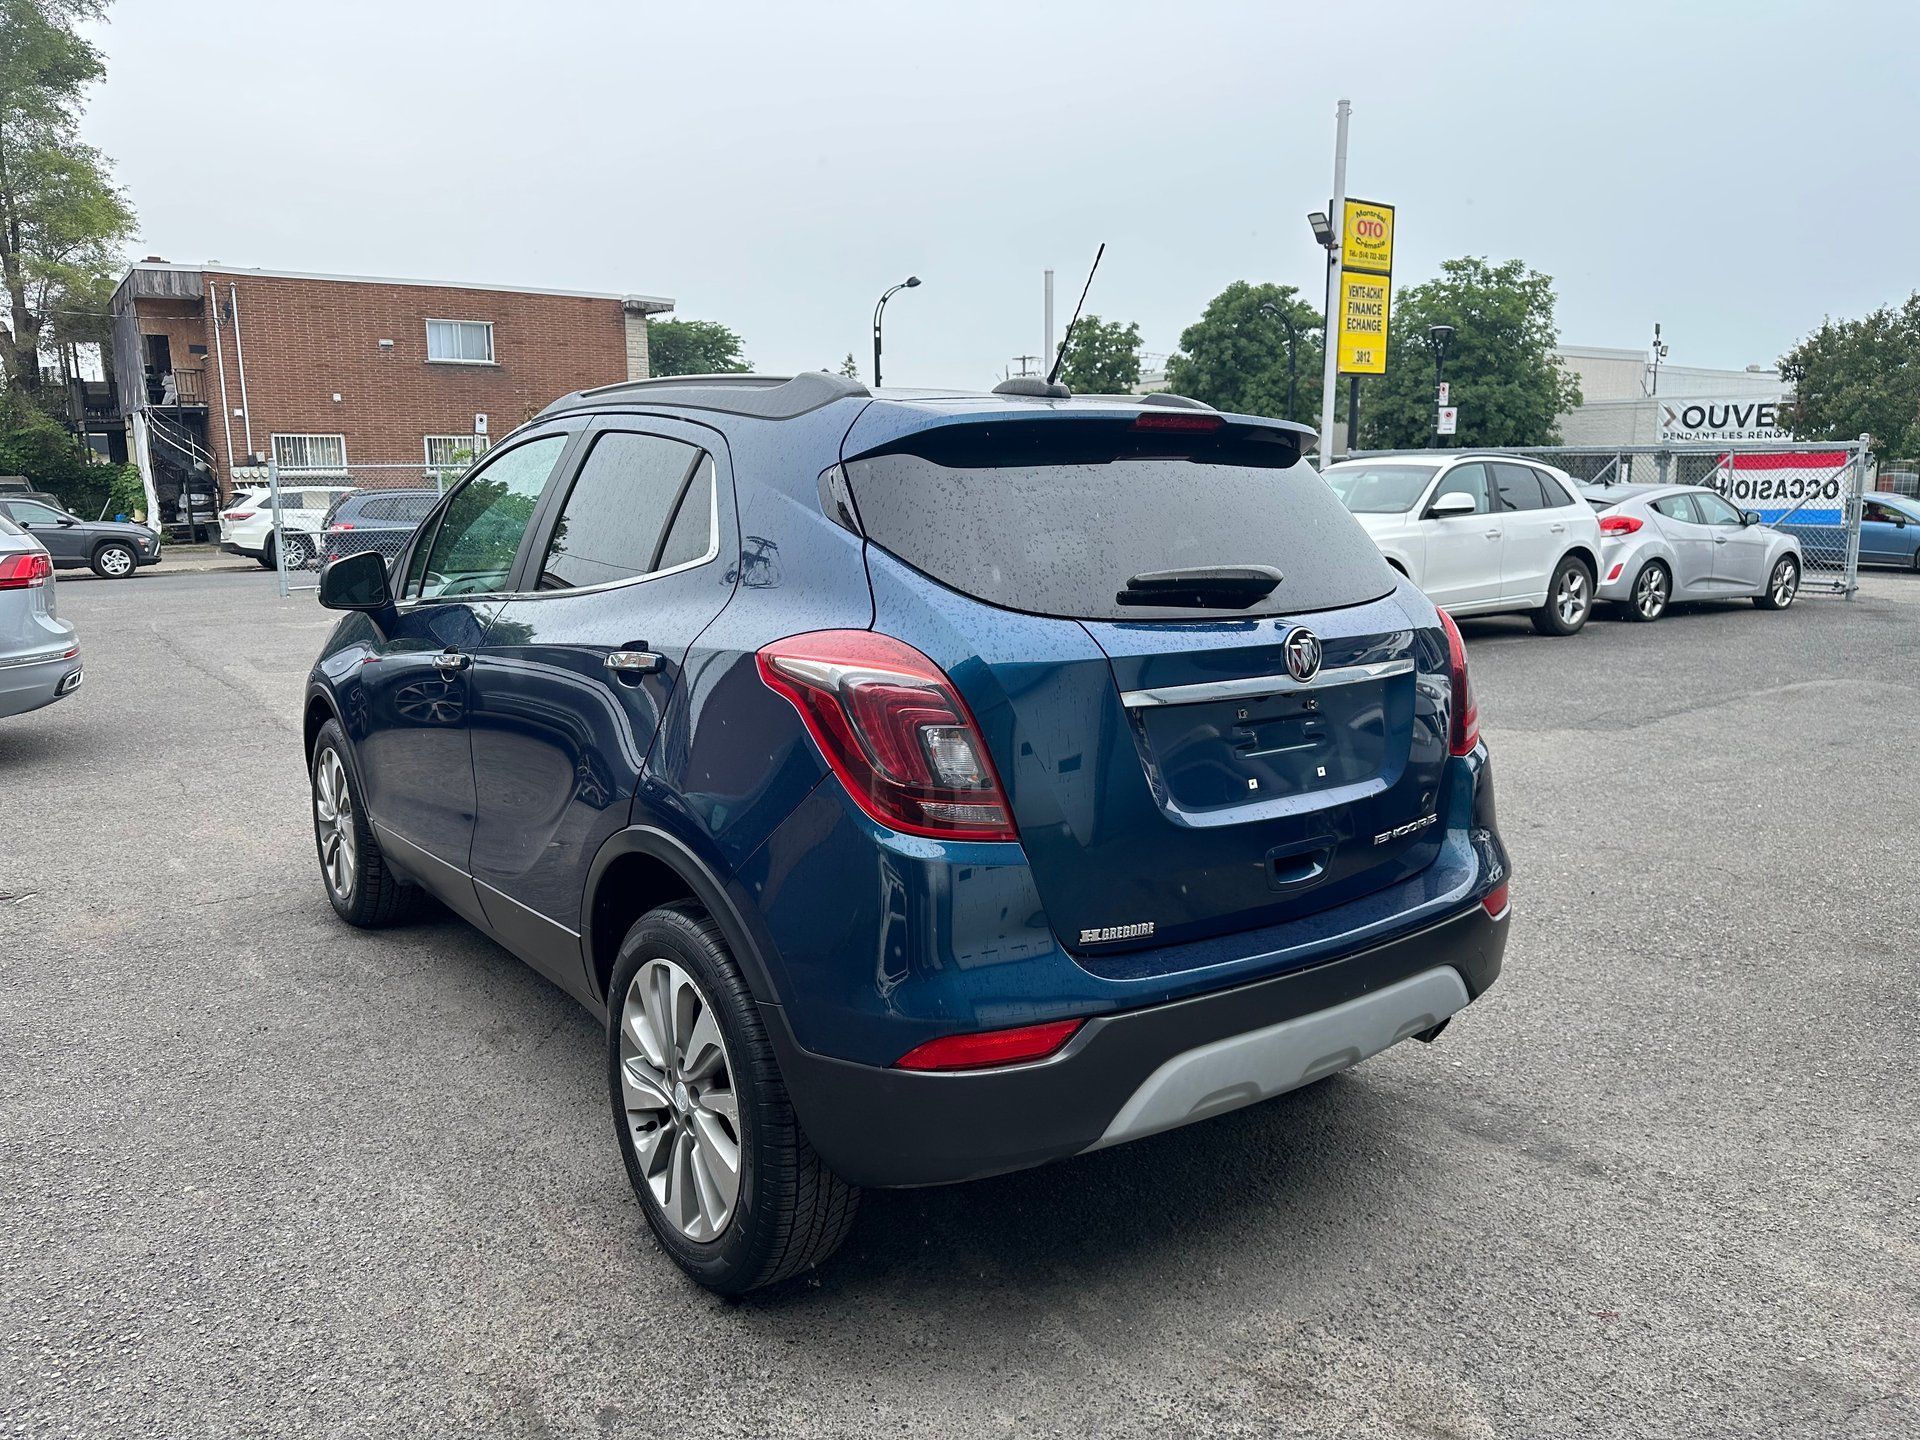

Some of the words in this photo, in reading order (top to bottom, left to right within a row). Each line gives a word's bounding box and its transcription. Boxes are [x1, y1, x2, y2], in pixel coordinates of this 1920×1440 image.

[1356, 210, 1386, 223] Montréal
[1357, 220, 1383, 238] OTO
[1355, 237, 1385, 249] Crémazie
[1348, 285, 1384, 299] VENTE-ACHAT
[1347, 301, 1382, 316] FINANCE
[1347, 317, 1382, 332] ECHANGE
[1356, 350, 1371, 363] 3812
[1681, 403, 1775, 430] OUVE
[1662, 432, 1717, 440] PENDANT
[1721, 431, 1743, 440] LES
[1748, 429, 1791, 440] RÉNOV
[1373, 813, 1438, 846] ENCORE
